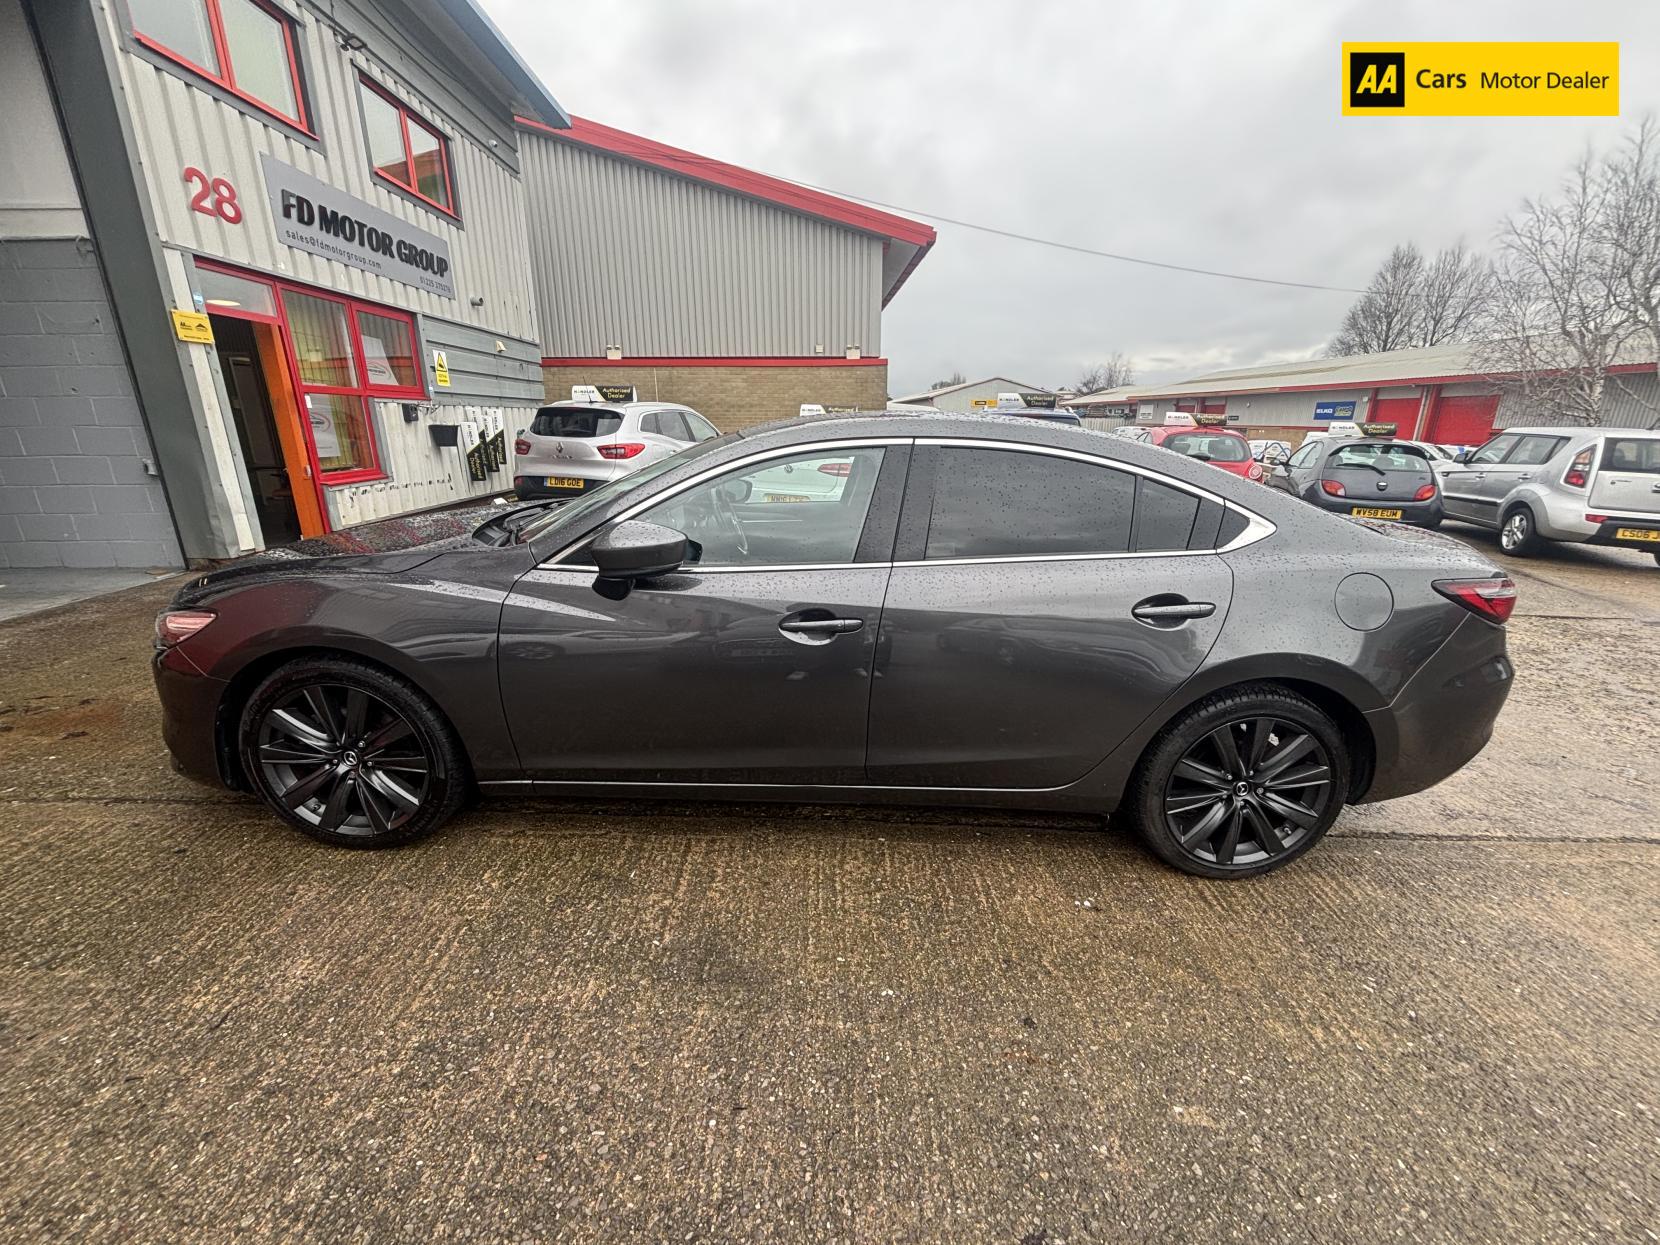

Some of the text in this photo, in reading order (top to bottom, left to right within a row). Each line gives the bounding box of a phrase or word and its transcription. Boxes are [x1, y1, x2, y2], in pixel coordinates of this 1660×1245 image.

[184, 166, 243, 225] 28
[281, 188, 449, 278] FD MOTOR GROUP
[285, 229, 382, 271] sales@fdmotorgroup.com
[474, 452, 484, 479] Authorised
[1356, 509, 1398, 518] WV58 EUM
[1621, 529, 1650, 539] CS06
